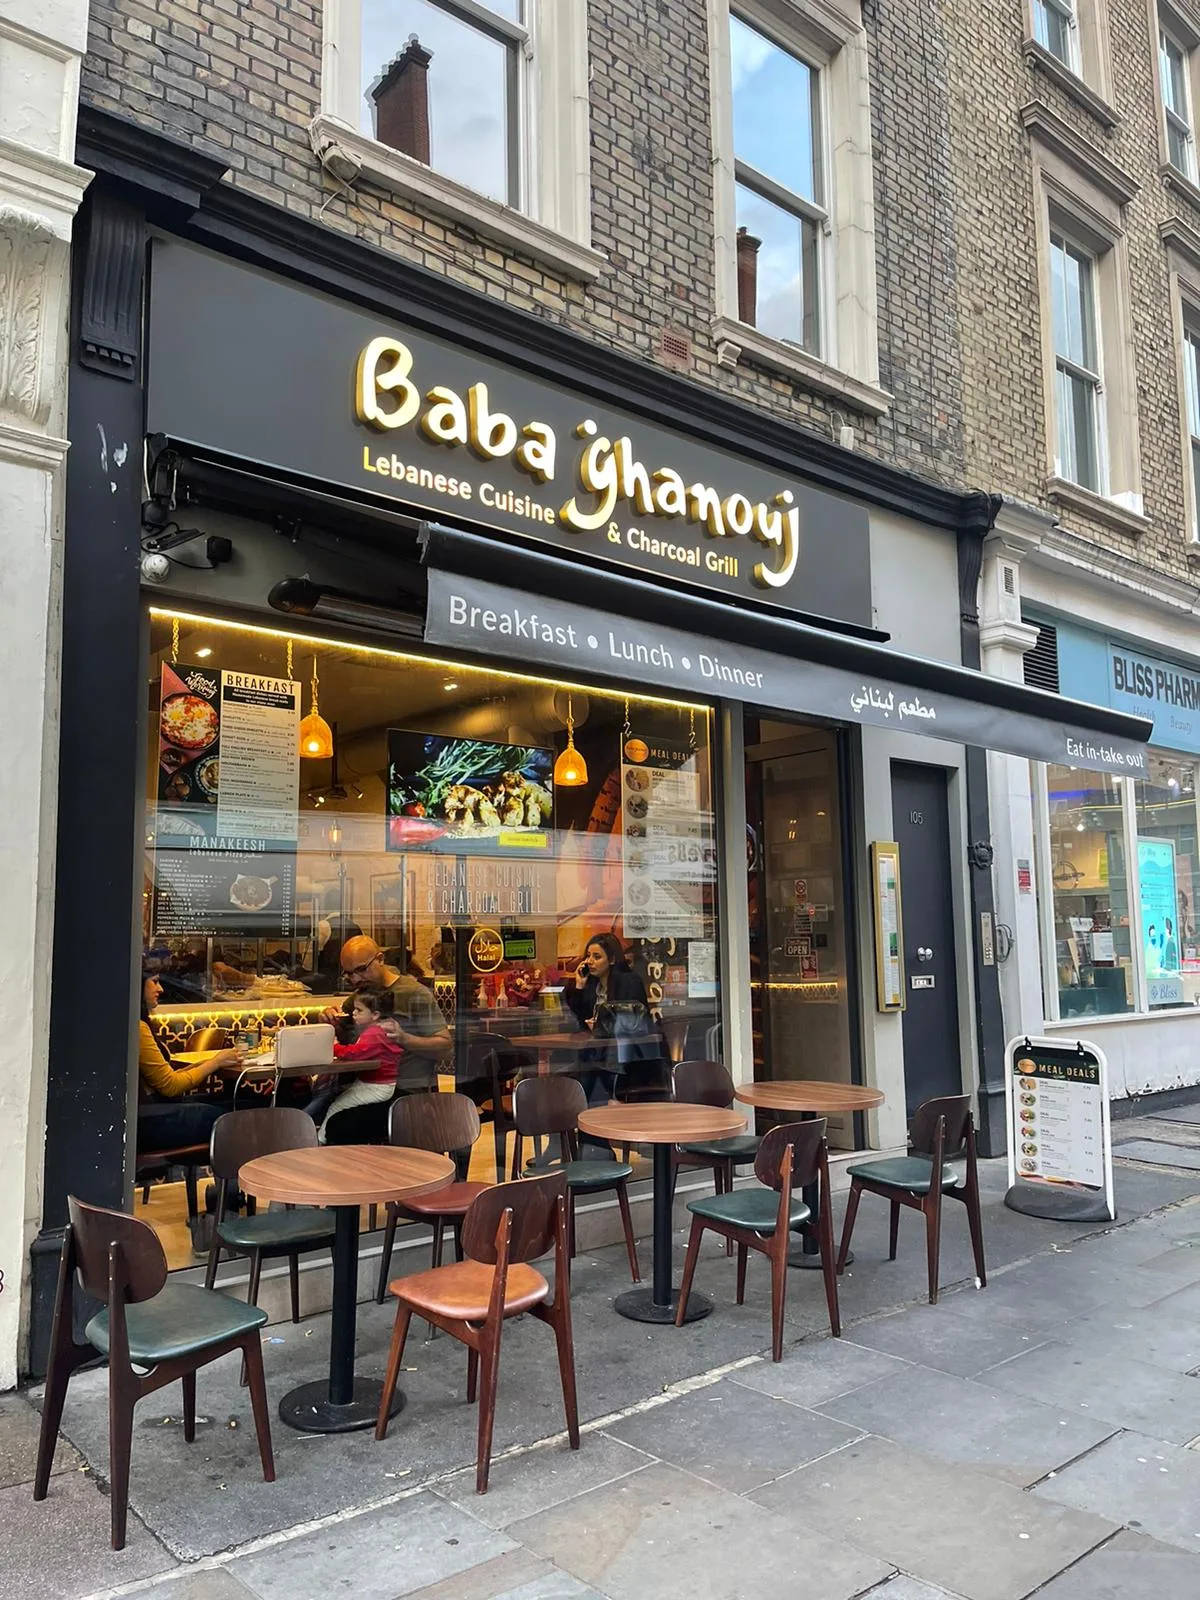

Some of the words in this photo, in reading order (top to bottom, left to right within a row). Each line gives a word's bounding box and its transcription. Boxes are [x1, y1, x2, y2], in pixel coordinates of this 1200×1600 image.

[355, 337, 557, 482] Baba
[363, 446, 472, 499] Lebanese
[479, 483, 555, 525] Cuisine
[607, 522, 621, 545] &
[627, 529, 701, 567] Charcoal
[705, 551, 738, 577] Grill
[449, 595, 578, 649] Breakfast
[609, 632, 674, 669] Lunch
[700, 654, 764, 689] Dinner
[227, 674, 294, 694] BREAKFAST
[1113, 656, 1154, 699] BLISS
[850, 686, 894, 718] لبناني
[899, 697, 936, 720] مطعم
[651, 748, 670, 760] MEAL
[1066, 738, 1085, 758] Eat
[1086, 742, 1124, 764] in-take
[1126, 753, 1144, 768] out
[910, 810, 923, 825] 105
[190, 836, 266, 851] MANAKEESH
[496, 864, 542, 888] CUISINE
[442, 890, 501, 913] CHARCOAL
[510, 891, 542, 913] GRILL
[788, 946, 807, 955] OPEN
[1160, 984, 1178, 999] Bliss
[1039, 1064, 1063, 1075] MEAL
[1066, 1067, 1096, 1079] DEALS
